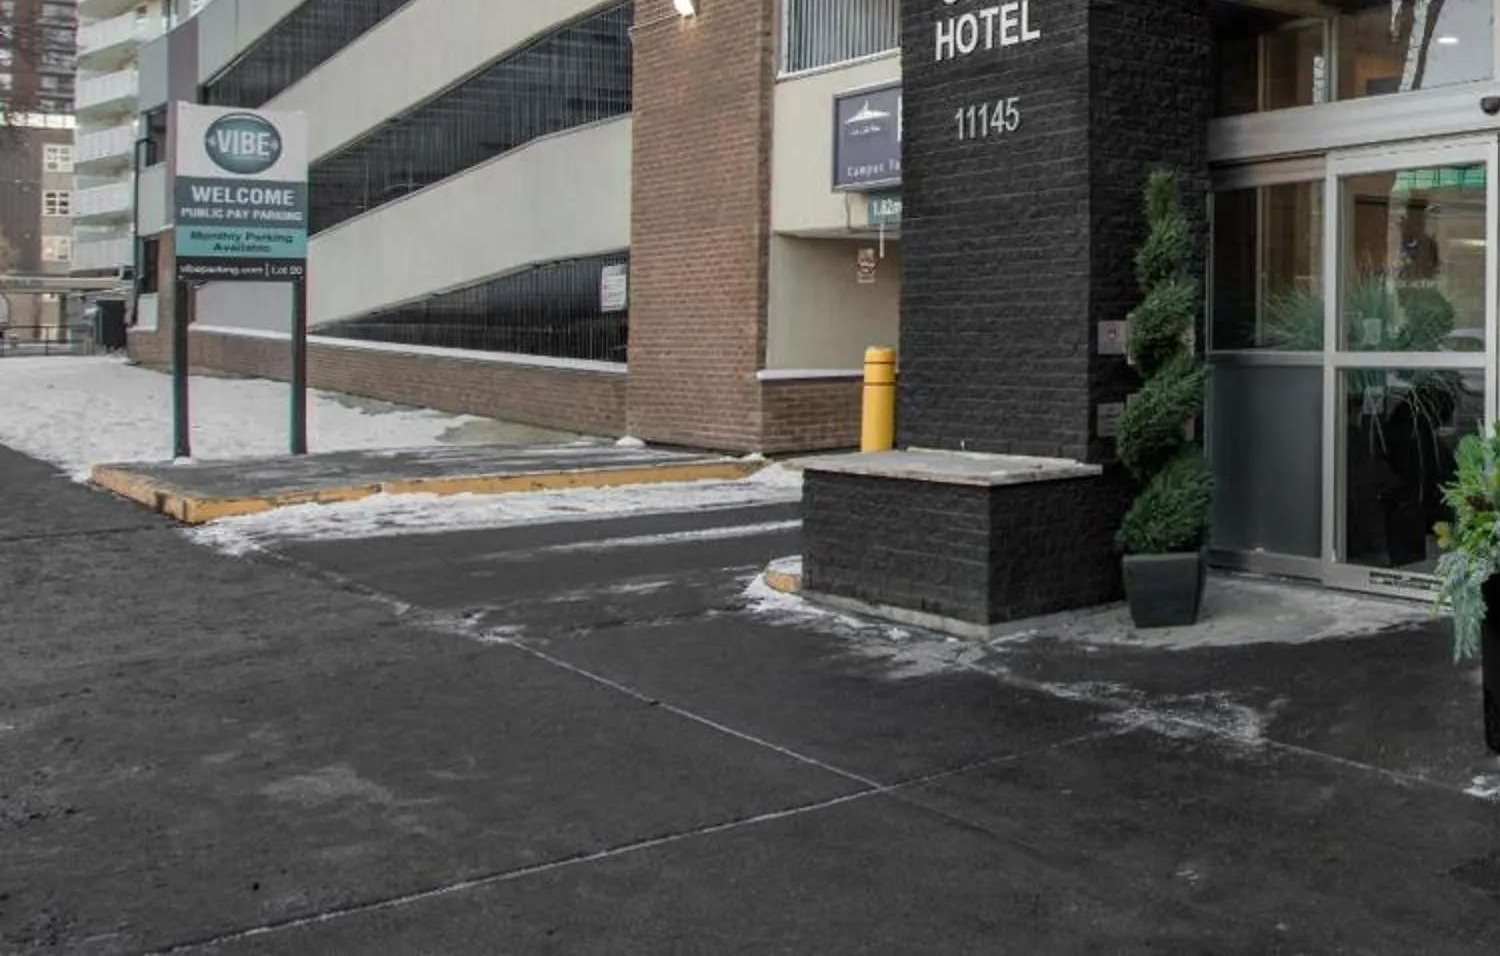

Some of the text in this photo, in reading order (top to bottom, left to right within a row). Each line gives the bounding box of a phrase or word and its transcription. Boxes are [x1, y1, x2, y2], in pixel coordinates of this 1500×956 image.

[935, 0, 1041, 62] HOTEL
[954, 96, 1020, 140] 11145
[216, 129, 271, 157] VIBE
[191, 185, 296, 206] WELCOME
[181, 206, 303, 222] PUBLIC PAY PARKING
[190, 230, 294, 244] Monthly Parking
[213, 243, 271, 253] Available
